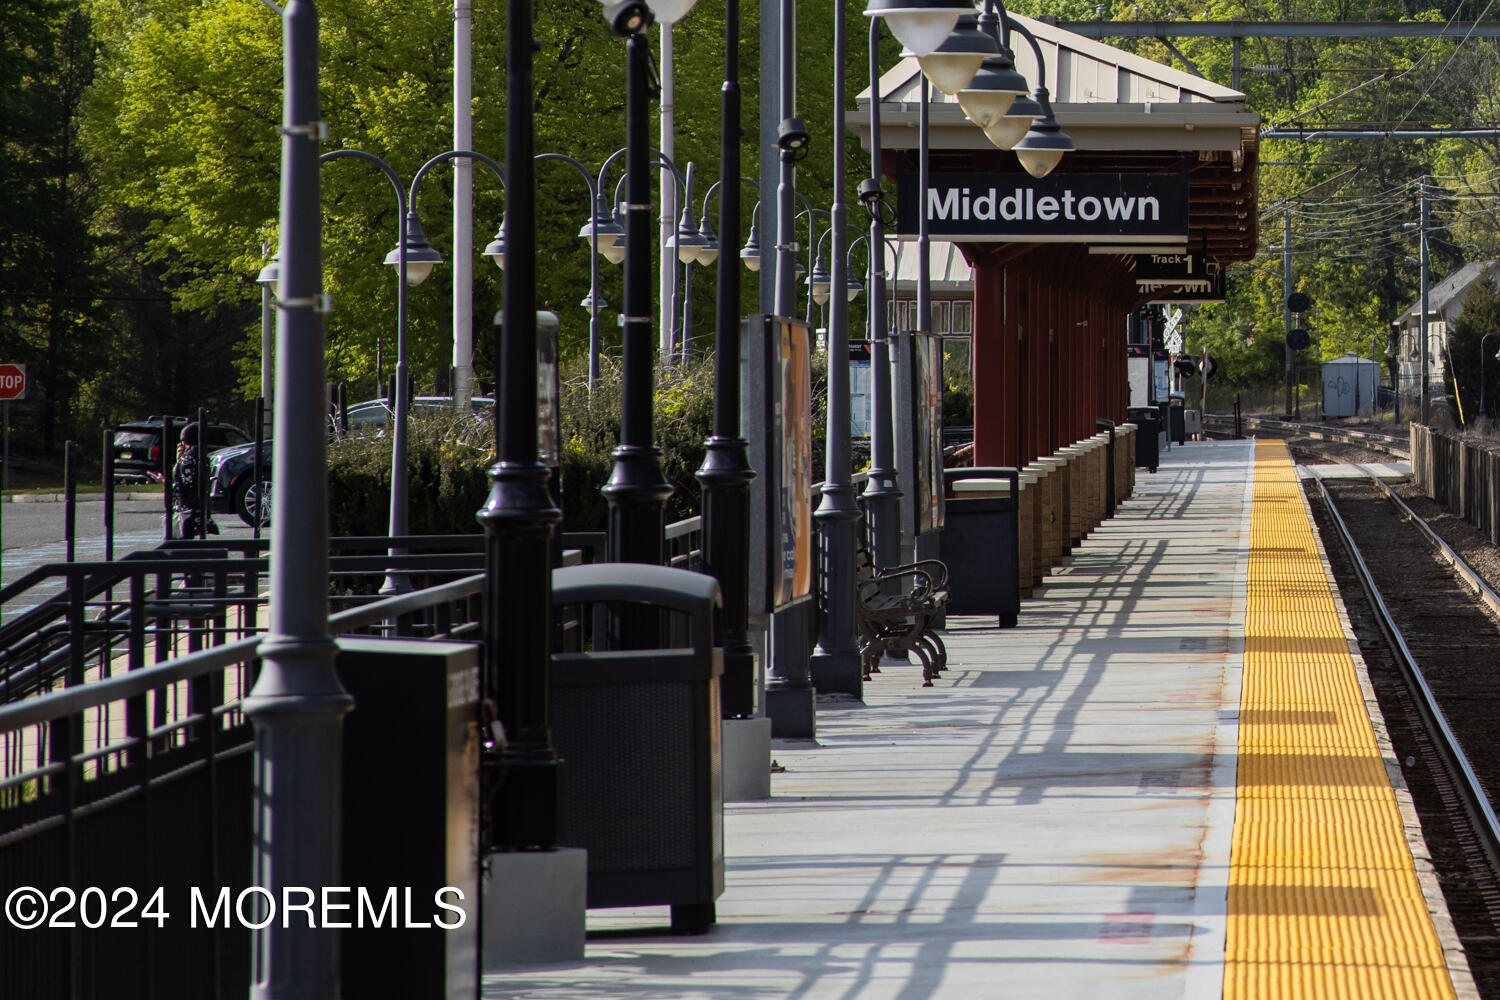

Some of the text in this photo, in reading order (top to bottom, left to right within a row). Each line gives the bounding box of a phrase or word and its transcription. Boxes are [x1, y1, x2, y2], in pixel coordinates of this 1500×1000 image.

[927, 187, 1160, 221] Middletown
[1151, 254, 1193, 274] Track 1
[0, 375, 23, 389] TOP
